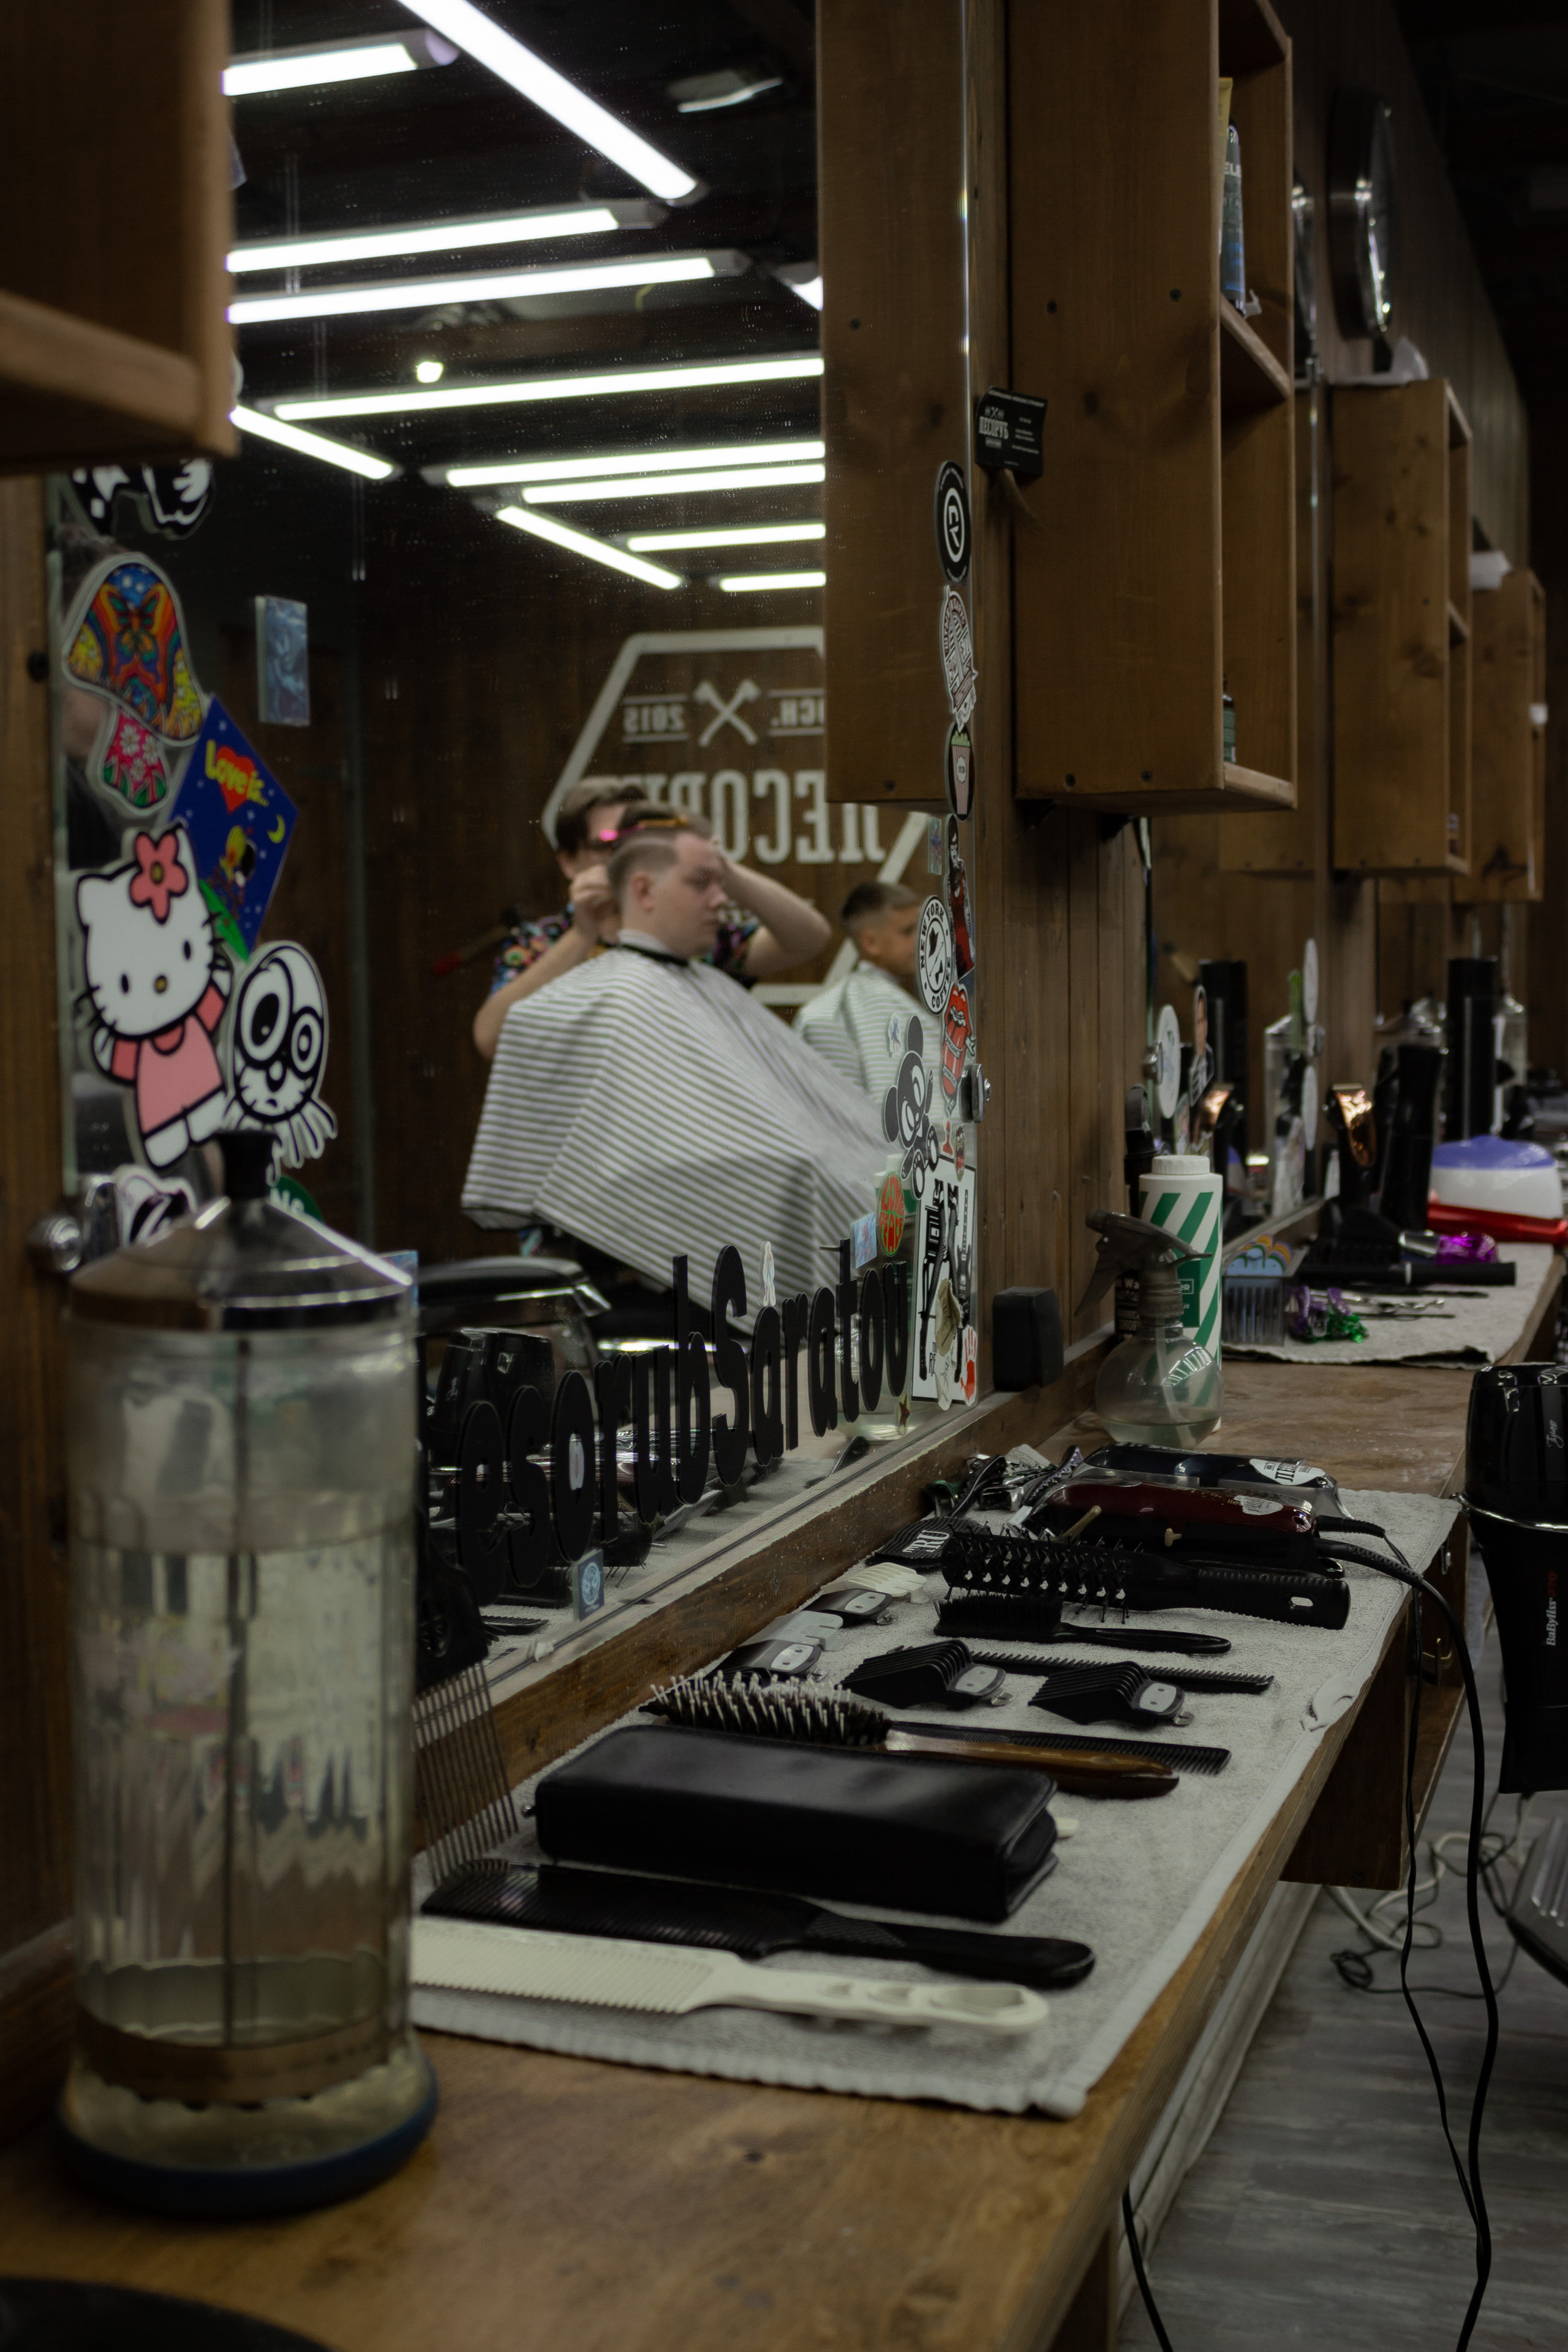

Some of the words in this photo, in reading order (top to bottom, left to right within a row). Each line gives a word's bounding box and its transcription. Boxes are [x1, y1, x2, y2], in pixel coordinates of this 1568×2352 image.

[926, 902, 944, 922] YORK
[932, 957, 951, 1009] COFFEE
[881, 1174, 904, 1216] LOVE
